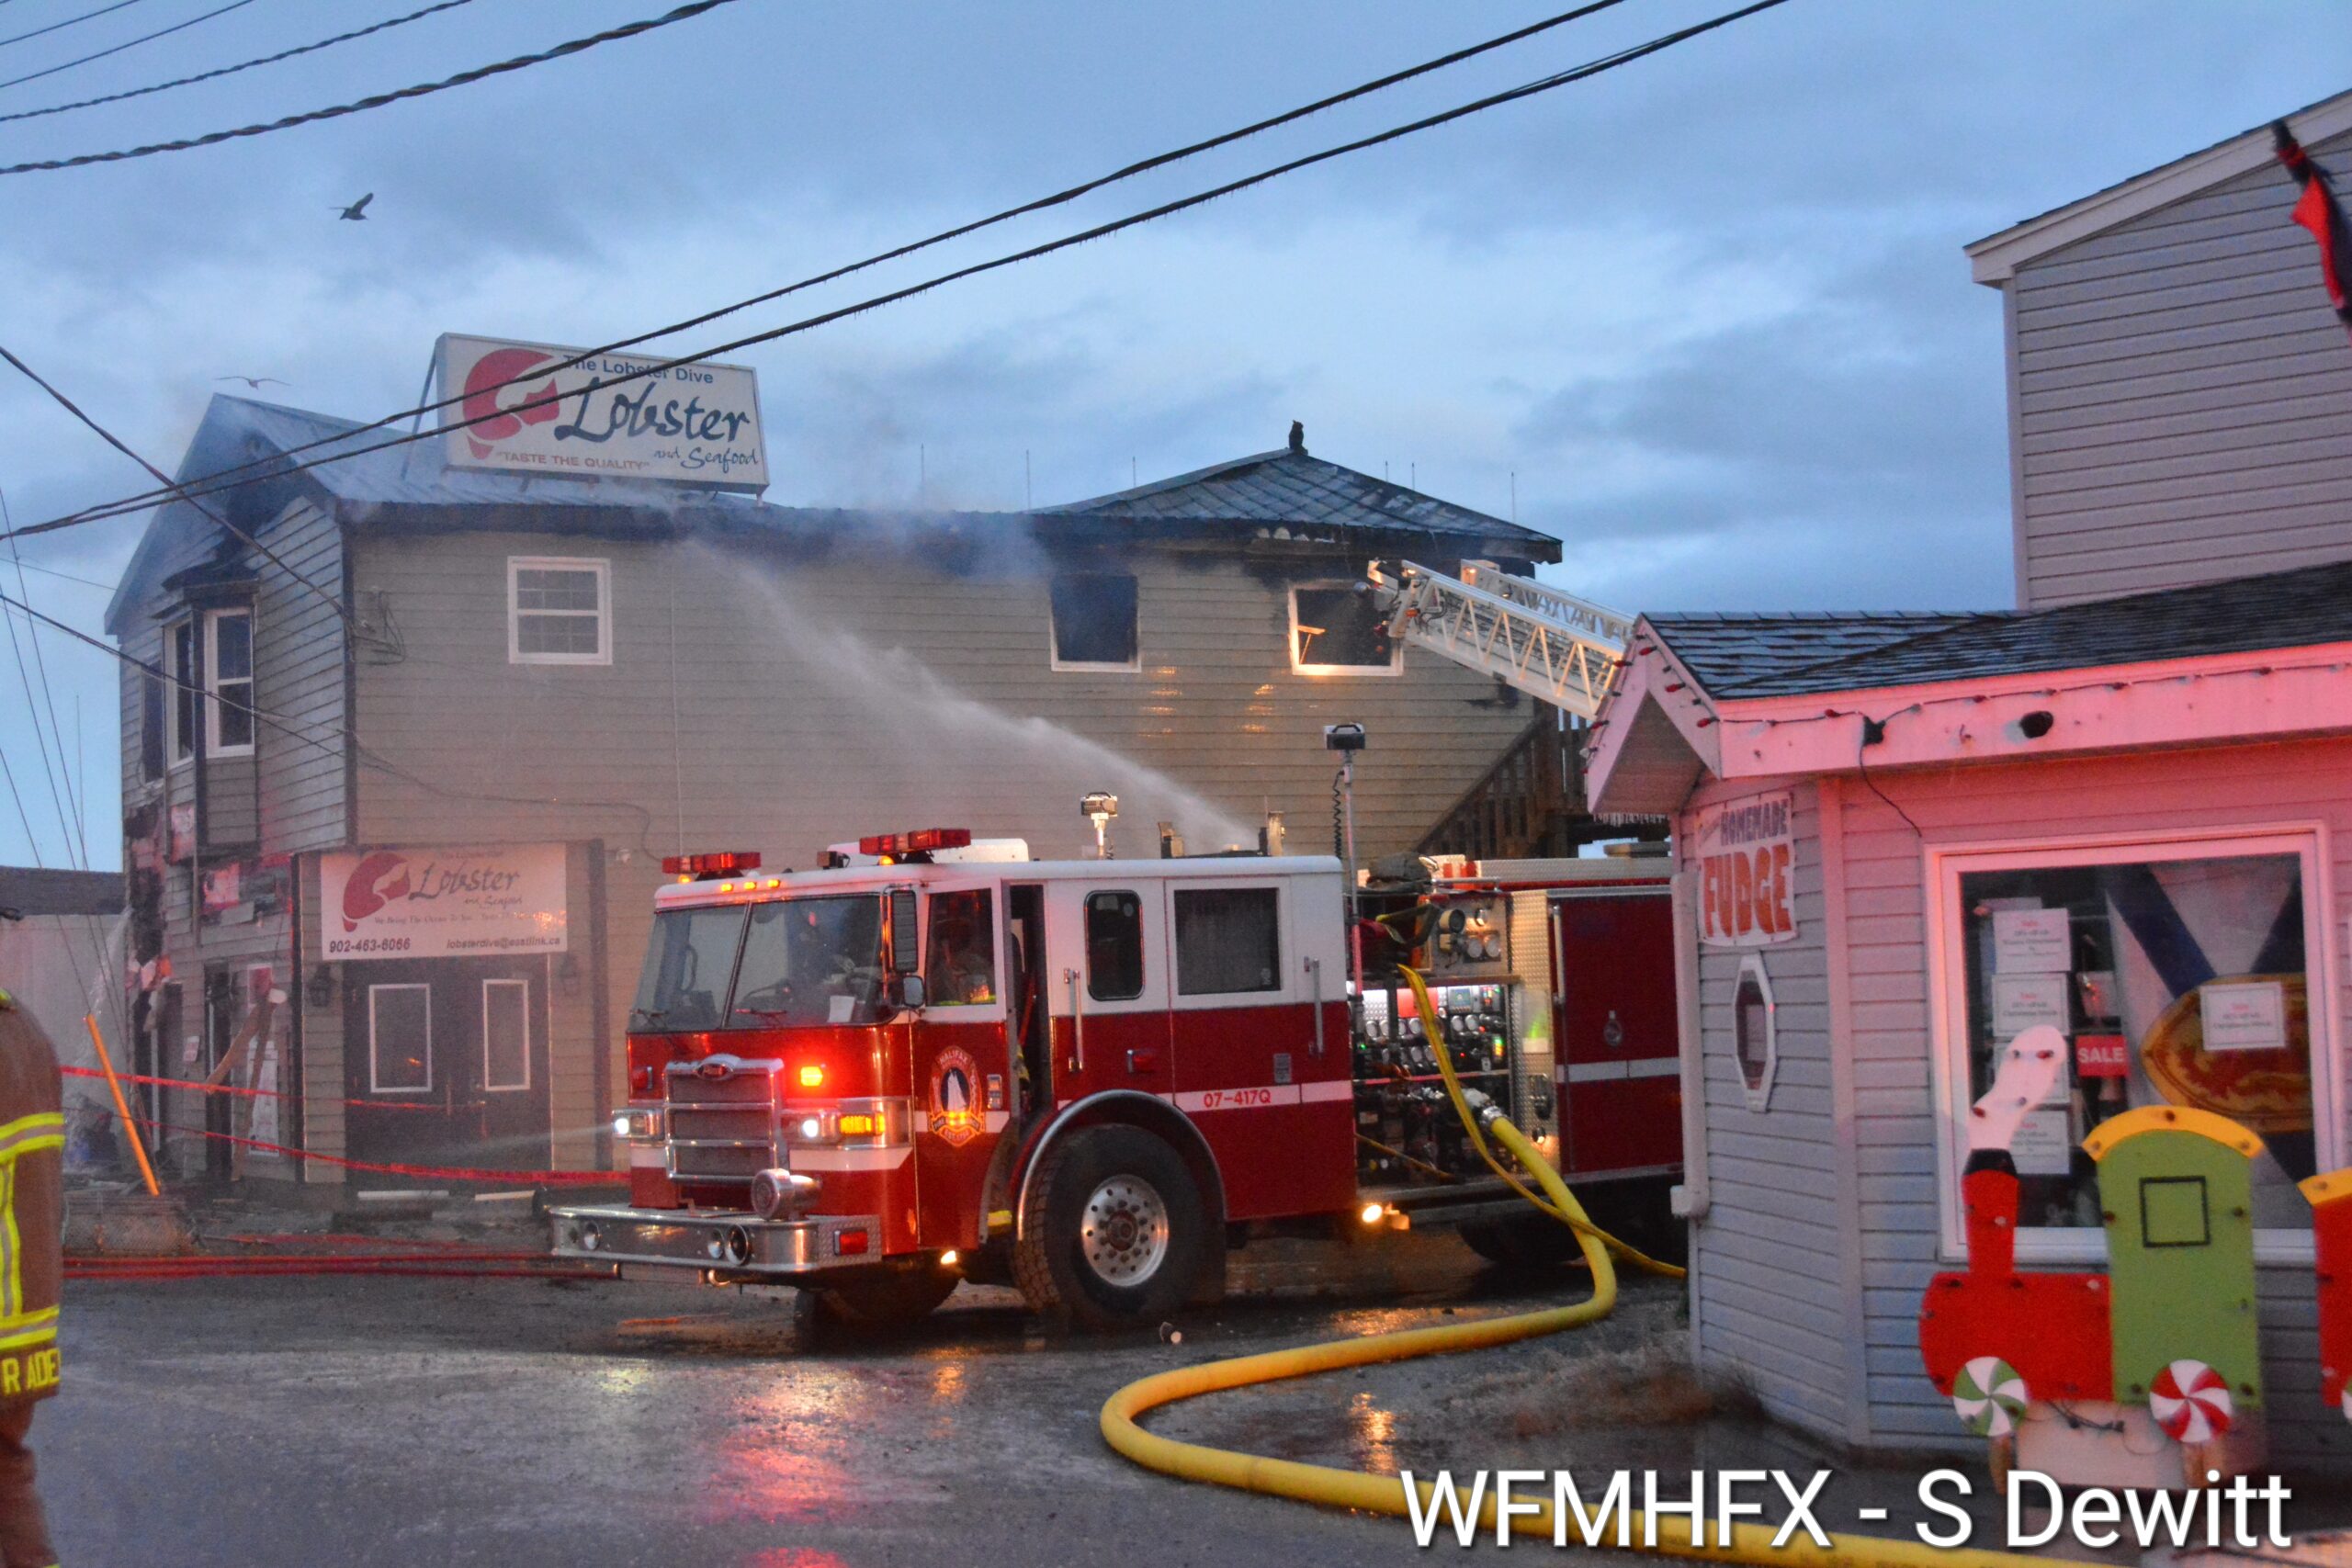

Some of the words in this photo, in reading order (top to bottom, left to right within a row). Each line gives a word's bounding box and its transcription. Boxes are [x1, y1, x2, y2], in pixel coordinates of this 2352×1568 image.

[676, 368, 714, 384] Dive
[554, 376, 750, 443] Lobster
[550, 455, 580, 467] THE
[680, 446, 759, 474] Seafood
[408, 862, 520, 900] Lobster
[1702, 844, 1792, 938] FUDGE
[2077, 1046, 2125, 1064] SALE
[1204, 1089, 1272, 1108] 07-417Q
